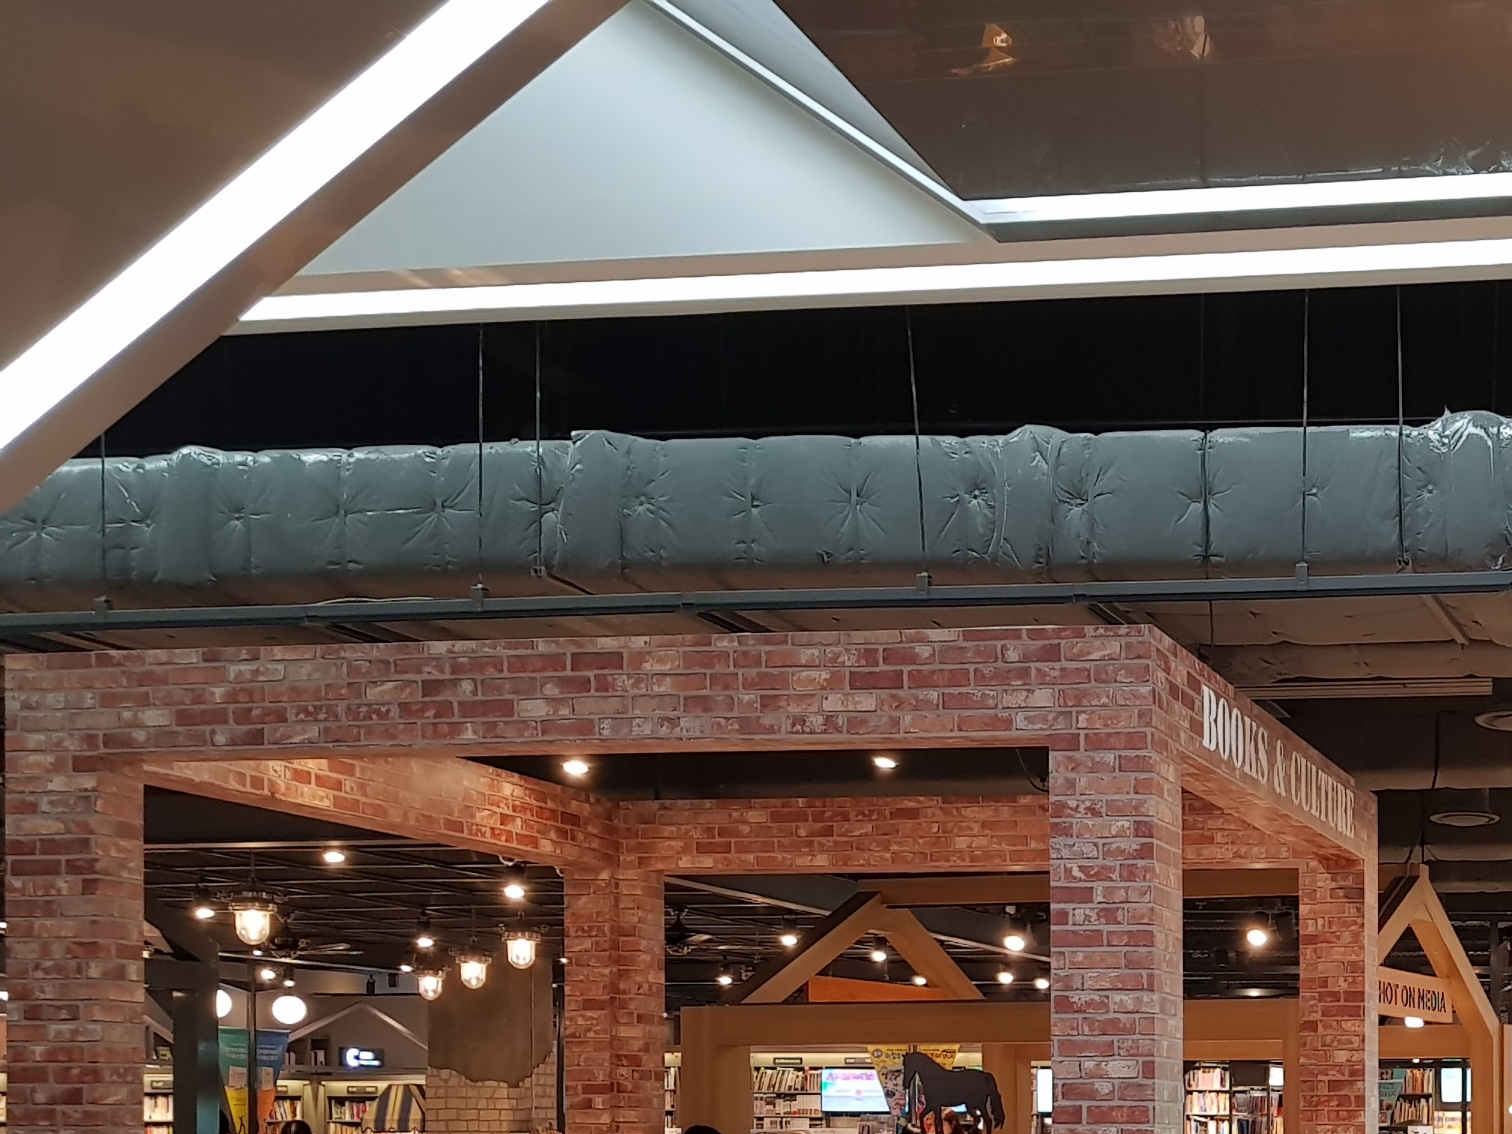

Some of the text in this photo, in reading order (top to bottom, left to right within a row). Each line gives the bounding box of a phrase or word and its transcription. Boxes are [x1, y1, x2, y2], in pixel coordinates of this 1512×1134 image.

[1202, 684, 1356, 839] BOOKS & CULTURE
[1378, 981, 1447, 1013] HOT ON MEDIA
